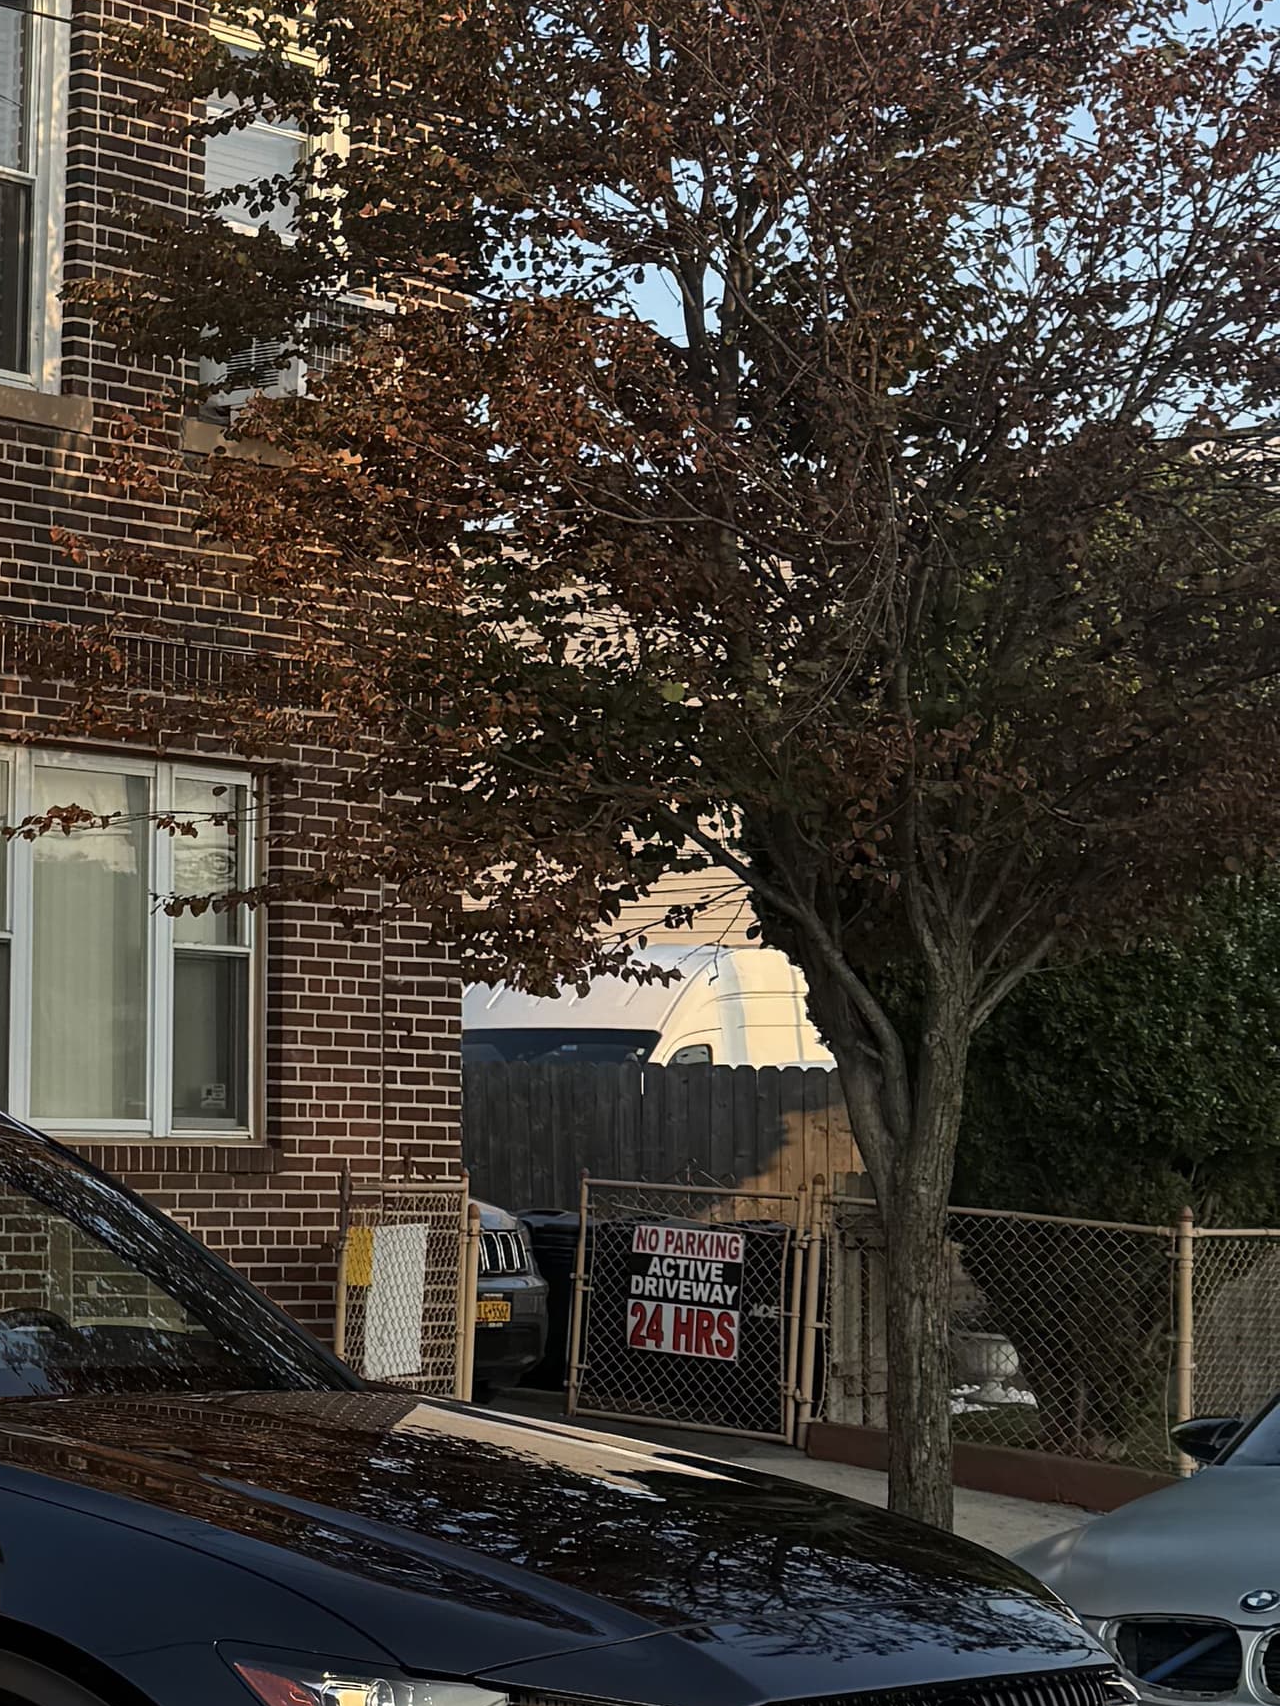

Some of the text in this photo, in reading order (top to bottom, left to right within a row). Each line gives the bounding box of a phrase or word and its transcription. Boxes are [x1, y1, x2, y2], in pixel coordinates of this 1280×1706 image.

[636, 1226, 741, 1261] NO PARKING
[647, 1256, 724, 1283] ACTIVE
[630, 1274, 739, 1306] DRIVEWAY
[629, 1301, 736, 1360] 24 HRS
